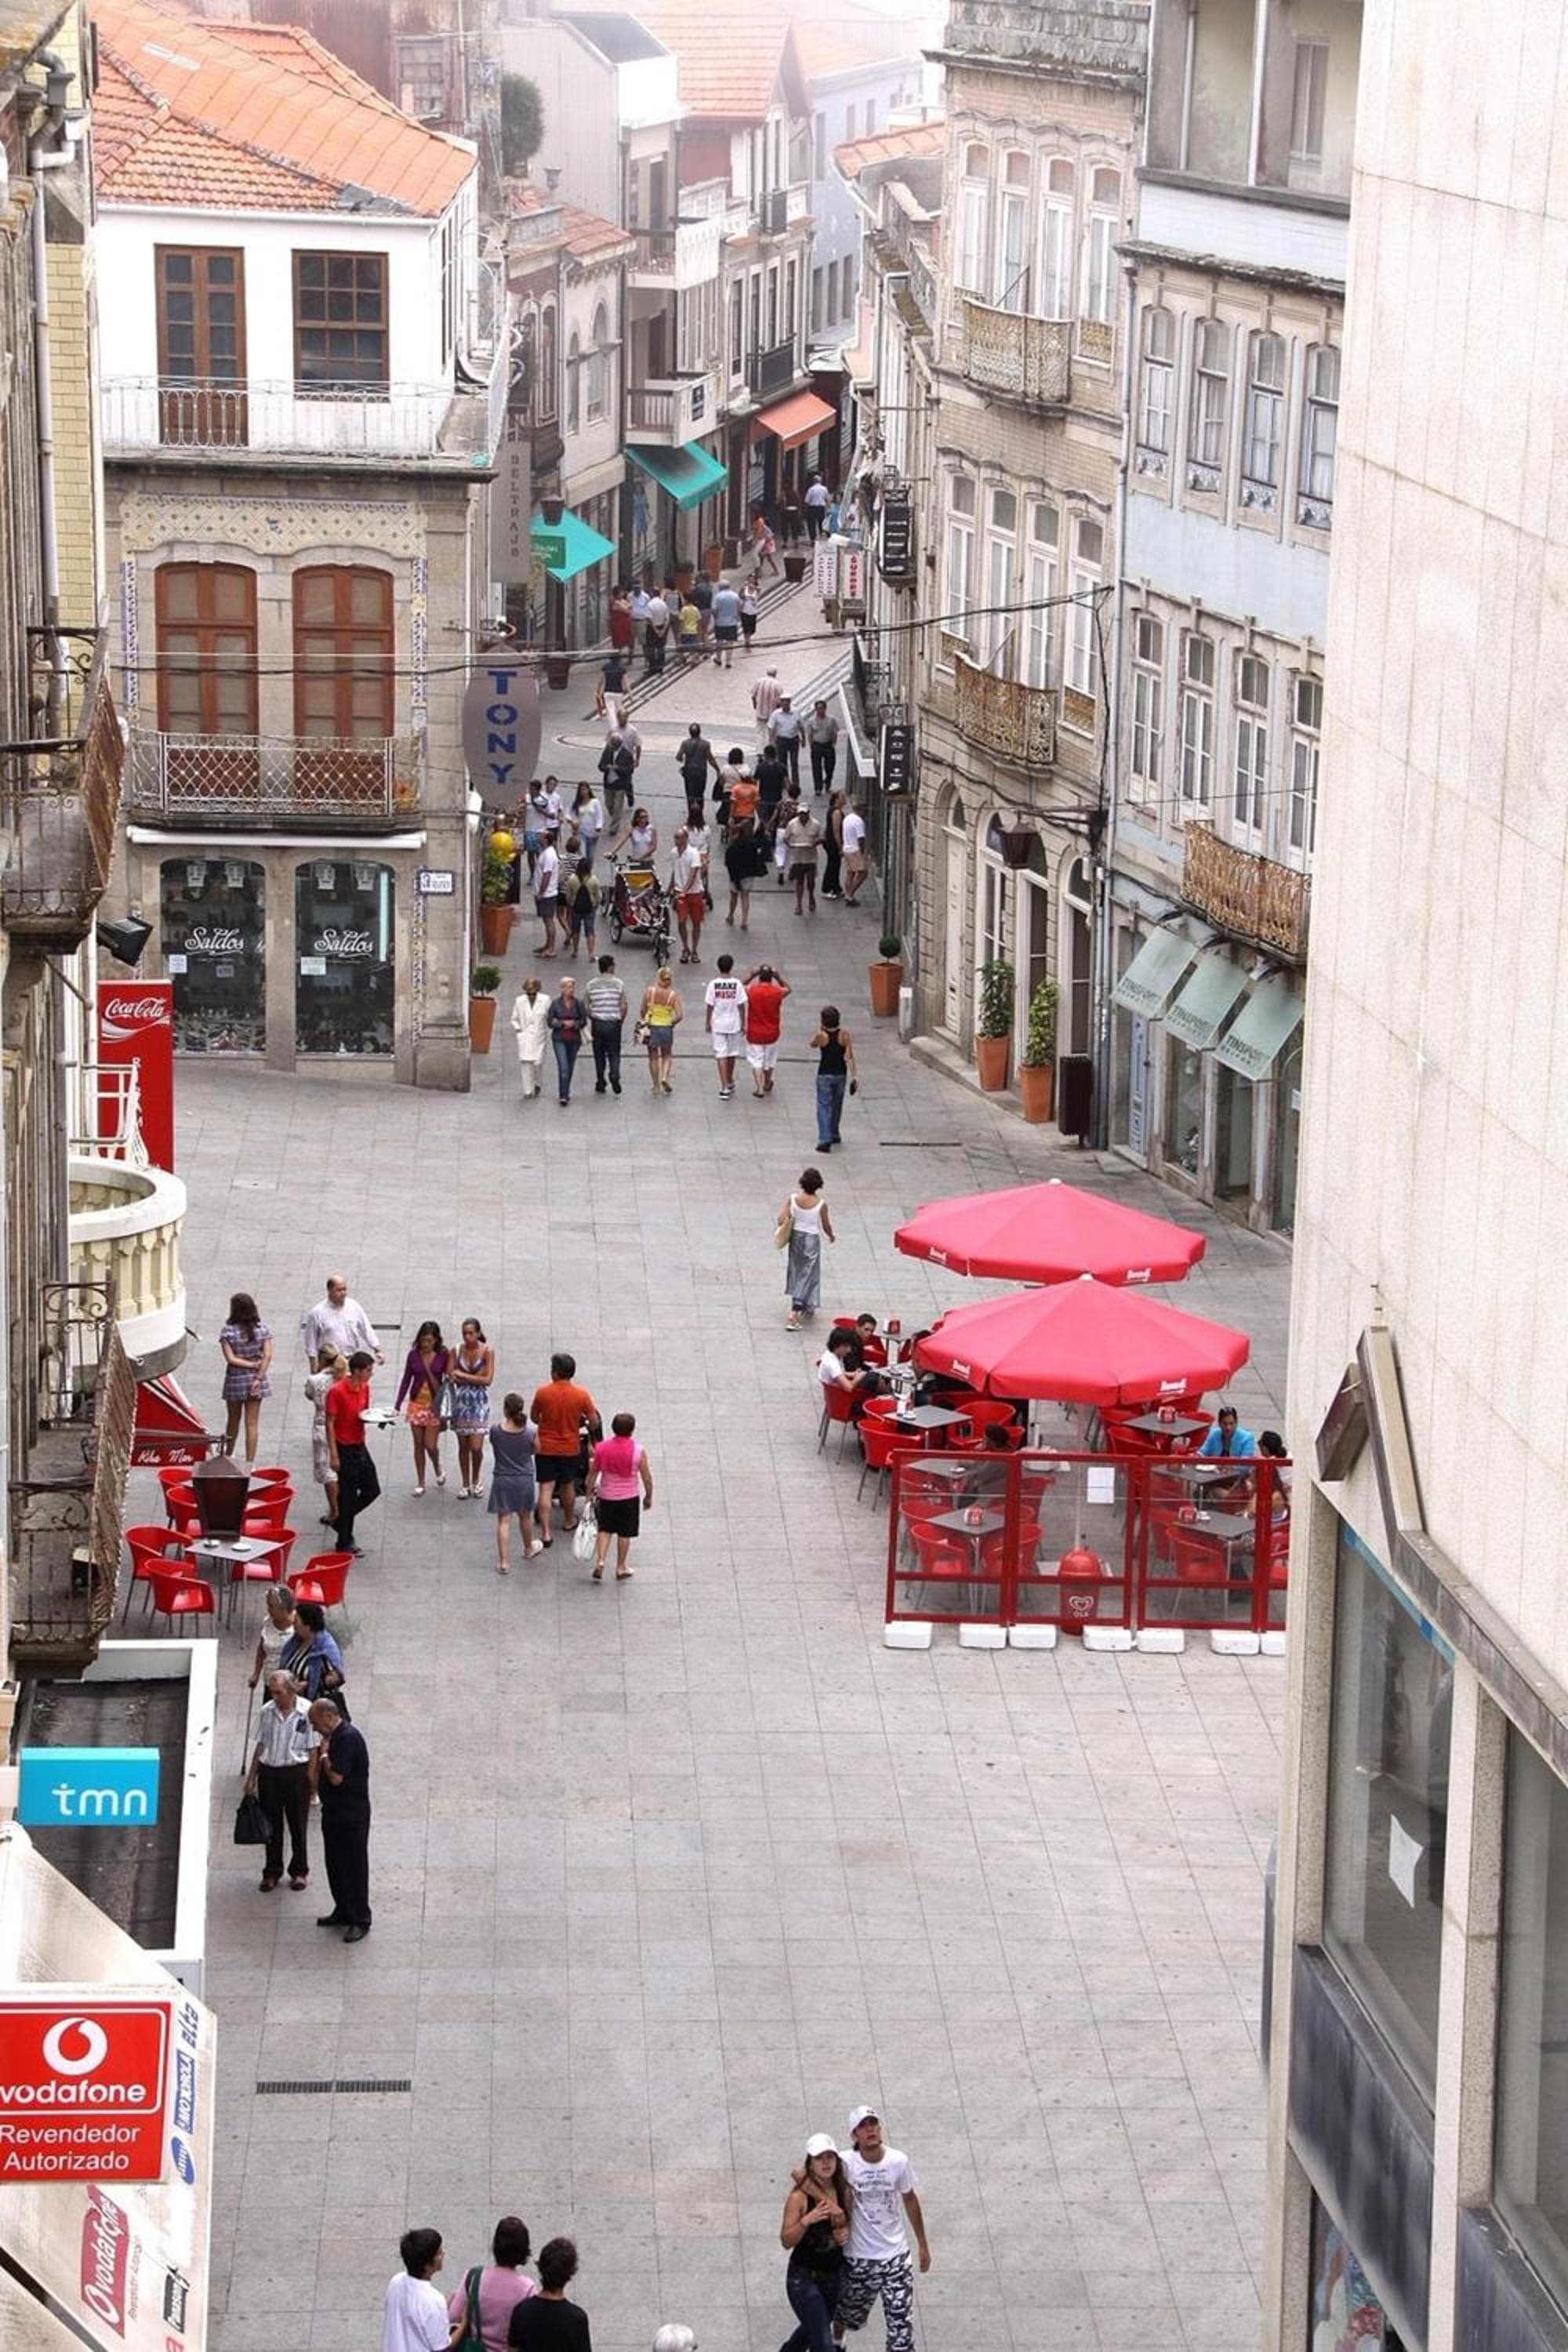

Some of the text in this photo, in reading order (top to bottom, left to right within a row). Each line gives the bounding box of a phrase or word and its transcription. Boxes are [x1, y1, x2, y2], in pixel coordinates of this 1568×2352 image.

[486, 670, 517, 783] TONY
[184, 926, 245, 952] Saldos
[314, 929, 374, 954] Saldos
[52, 1783, 147, 1817] tmn
[0, 2079, 147, 2104] vodafone
[0, 2123, 141, 2144] Revendedor
[3, 2151, 129, 2171] Autorizado
